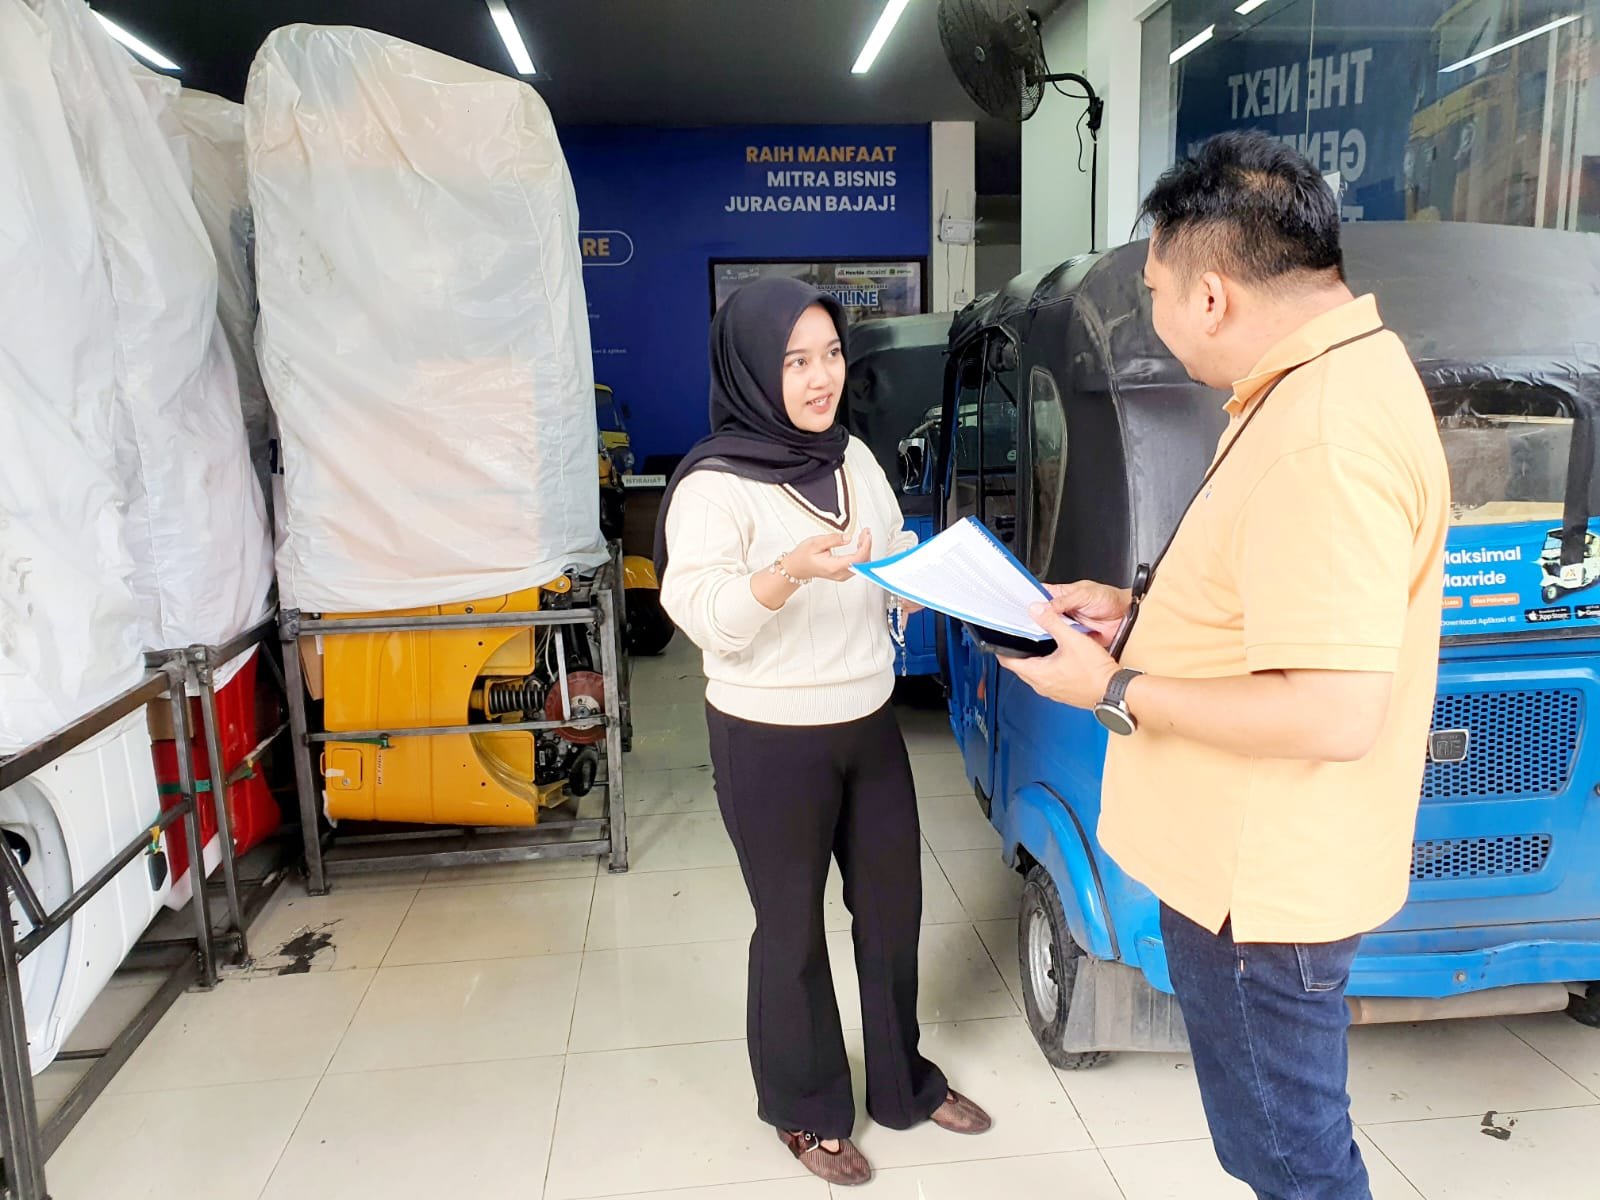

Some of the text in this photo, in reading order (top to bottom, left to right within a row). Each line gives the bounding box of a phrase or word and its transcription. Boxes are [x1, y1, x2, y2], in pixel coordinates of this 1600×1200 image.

[746, 146, 897, 163] RAIH MANFAAT
[767, 170, 897, 188] MITRA BISNIS
[724, 195, 896, 212] JURAGAN BAJAJ!
[821, 290, 878, 306] NLINE
